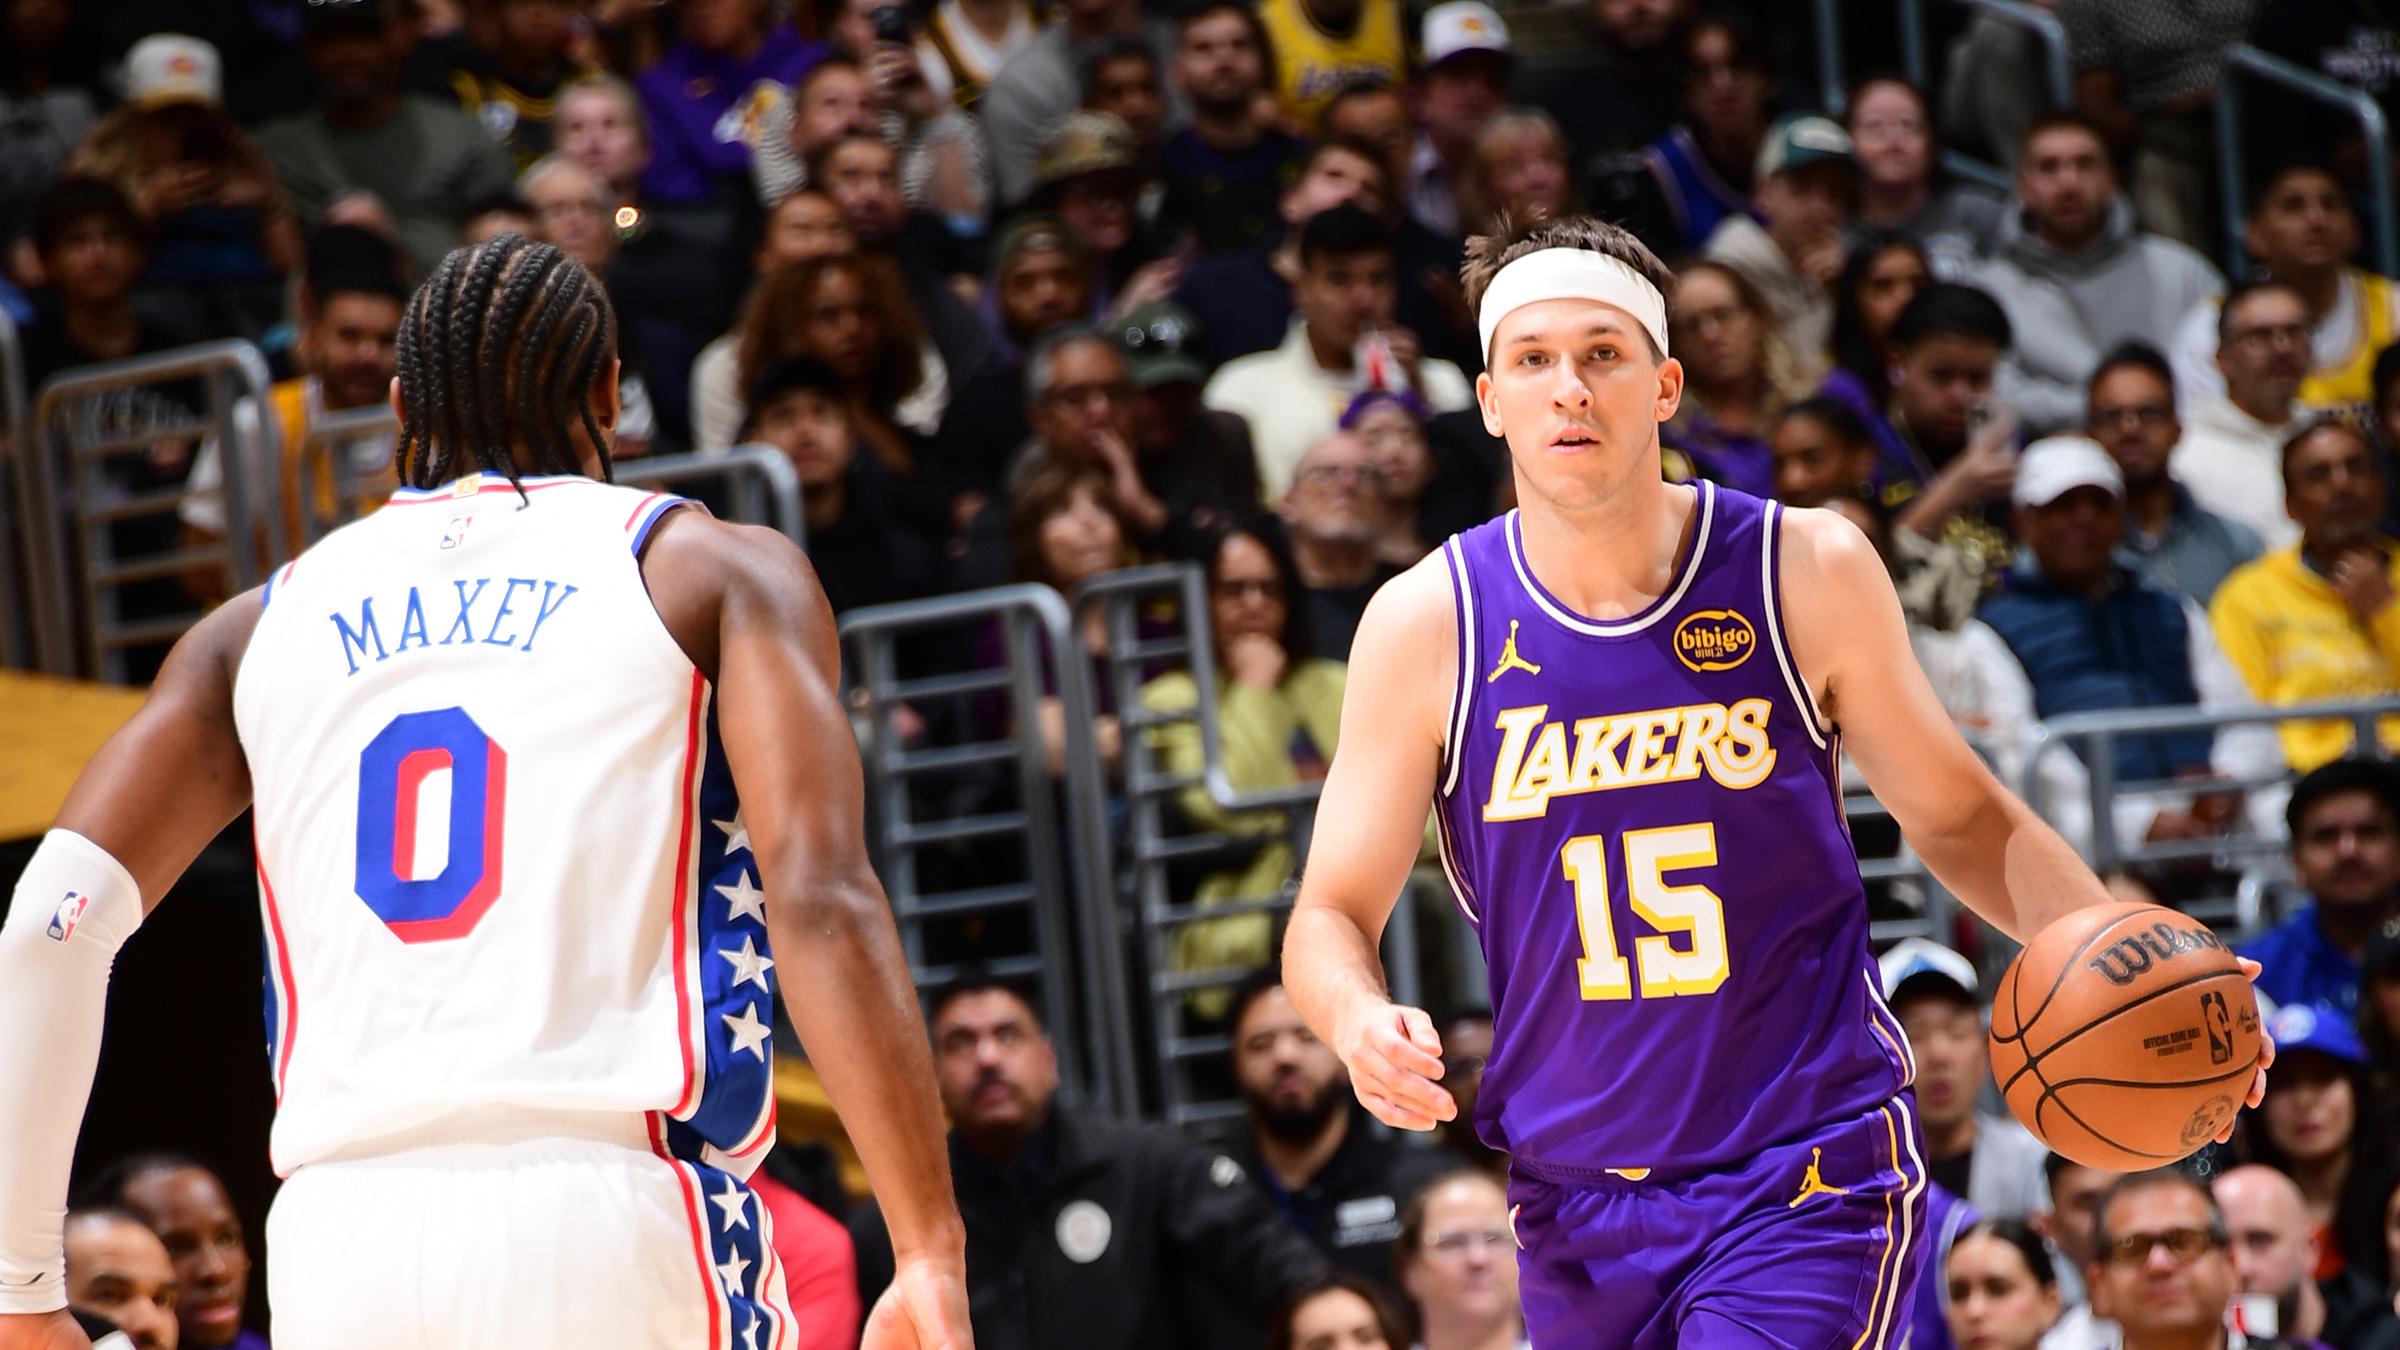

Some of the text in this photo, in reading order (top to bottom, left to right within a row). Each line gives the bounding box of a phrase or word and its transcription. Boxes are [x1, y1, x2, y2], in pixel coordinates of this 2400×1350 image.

[329, 577, 579, 677] MAXEY
[1681, 625, 1750, 652] bibigo
[1483, 697, 1777, 822] LAKERS
[353, 705, 508, 945] 0
[1560, 821, 1731, 1001] 15
